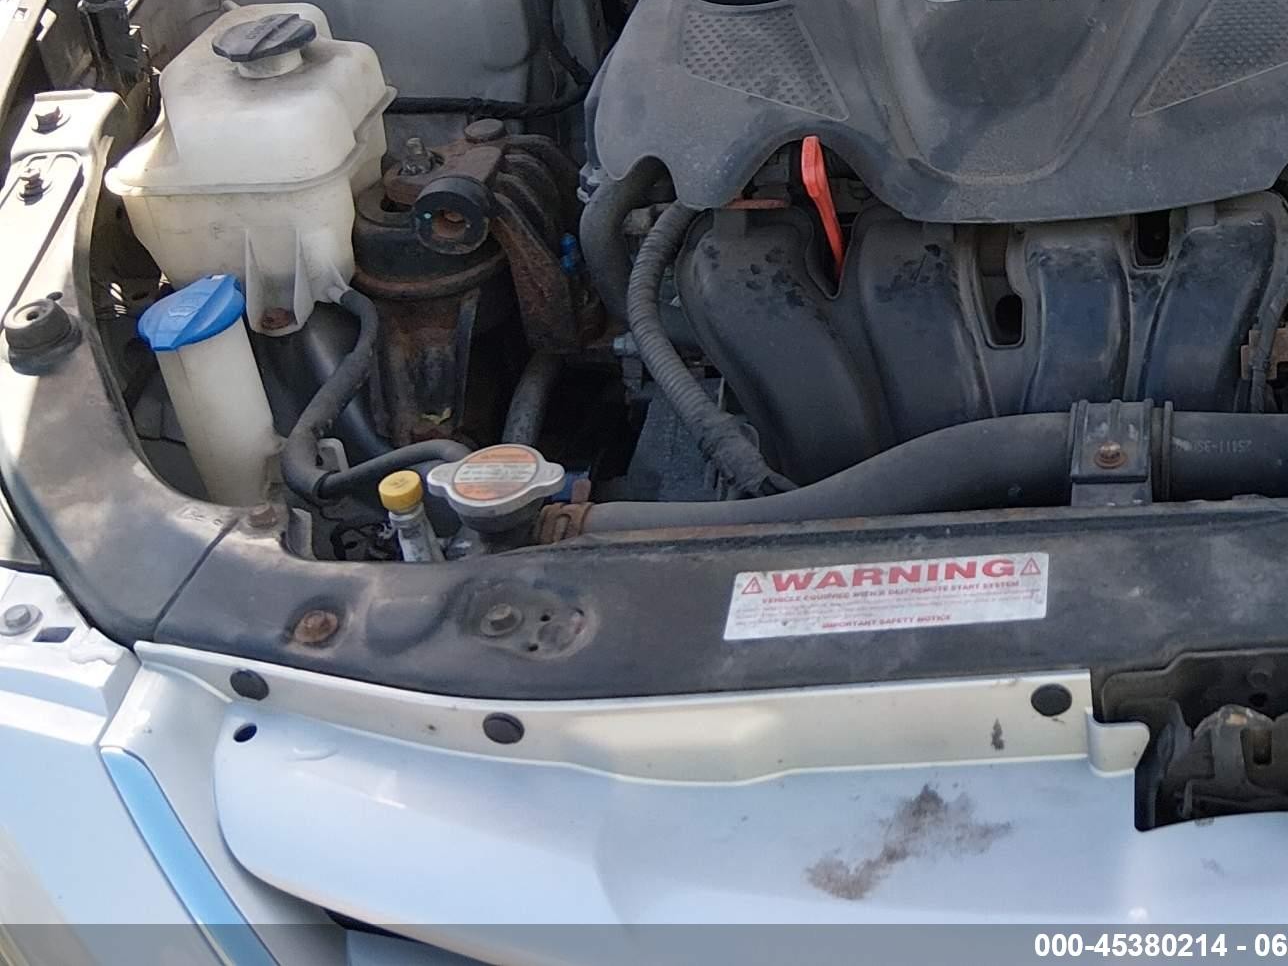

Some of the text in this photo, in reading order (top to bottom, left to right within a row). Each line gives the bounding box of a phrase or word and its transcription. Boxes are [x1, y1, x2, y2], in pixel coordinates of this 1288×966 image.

[772, 558, 1016, 591] WARNING
[950, 583, 980, 592] START
[983, 581, 1019, 589] SYSTEM
[822, 614, 951, 629] IMPORTANT SAFETY NOTICE
